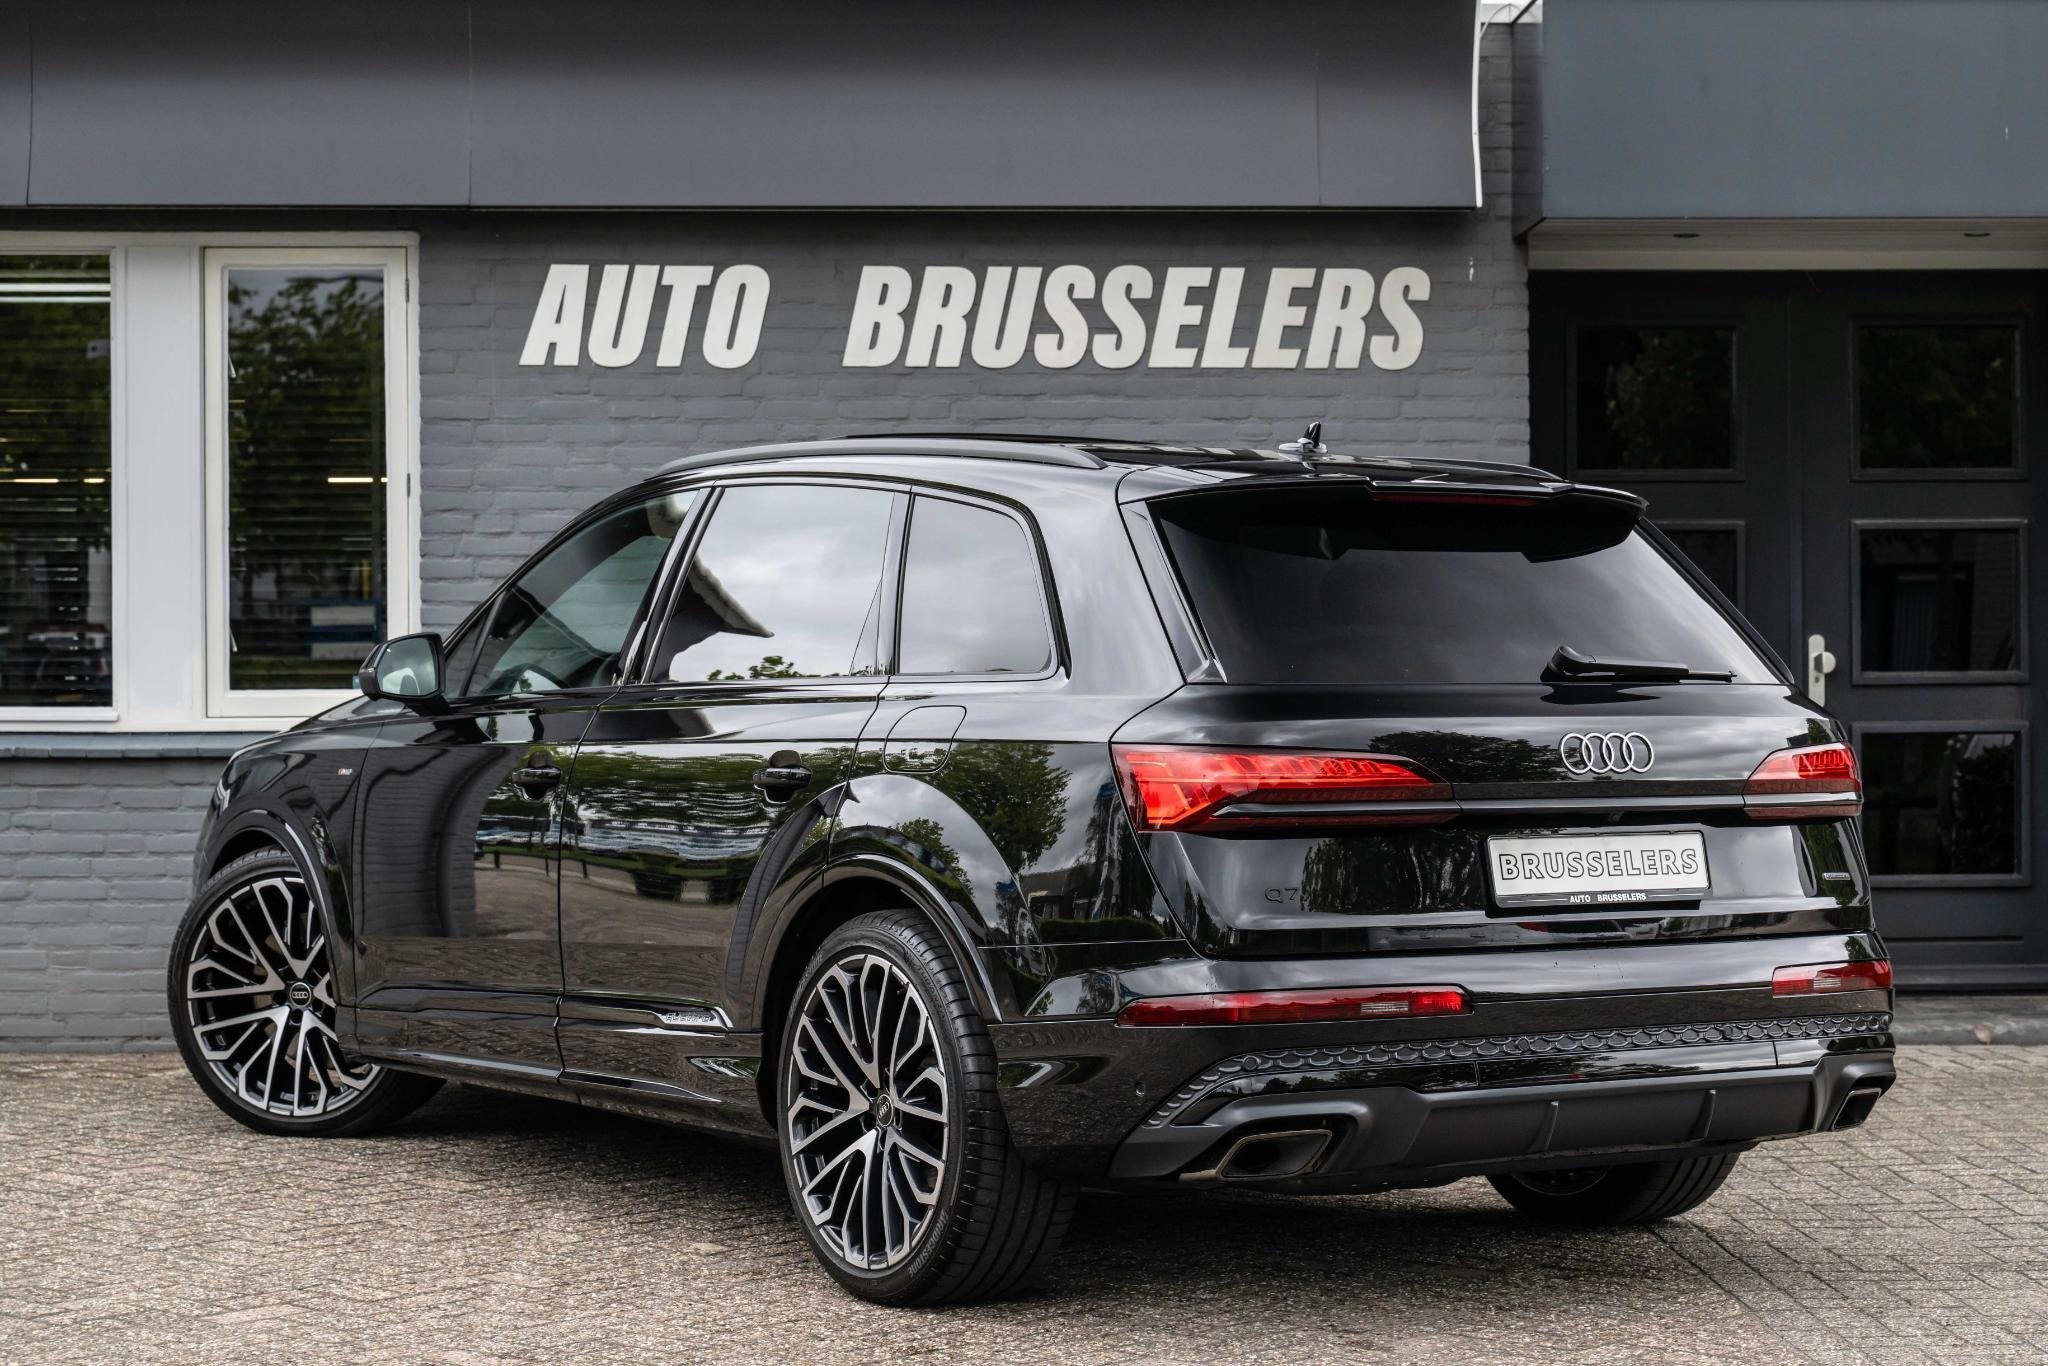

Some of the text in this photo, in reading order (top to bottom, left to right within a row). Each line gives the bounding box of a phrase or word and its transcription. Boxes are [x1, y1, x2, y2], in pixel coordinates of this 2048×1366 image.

[519, 263, 1432, 371] AUTO BRUSSELERS
[1498, 848, 1699, 881] BRUSSELERS
[1264, 887, 1298, 904] Q7
[1570, 892, 1647, 903] AUTO BRUSSELERS
